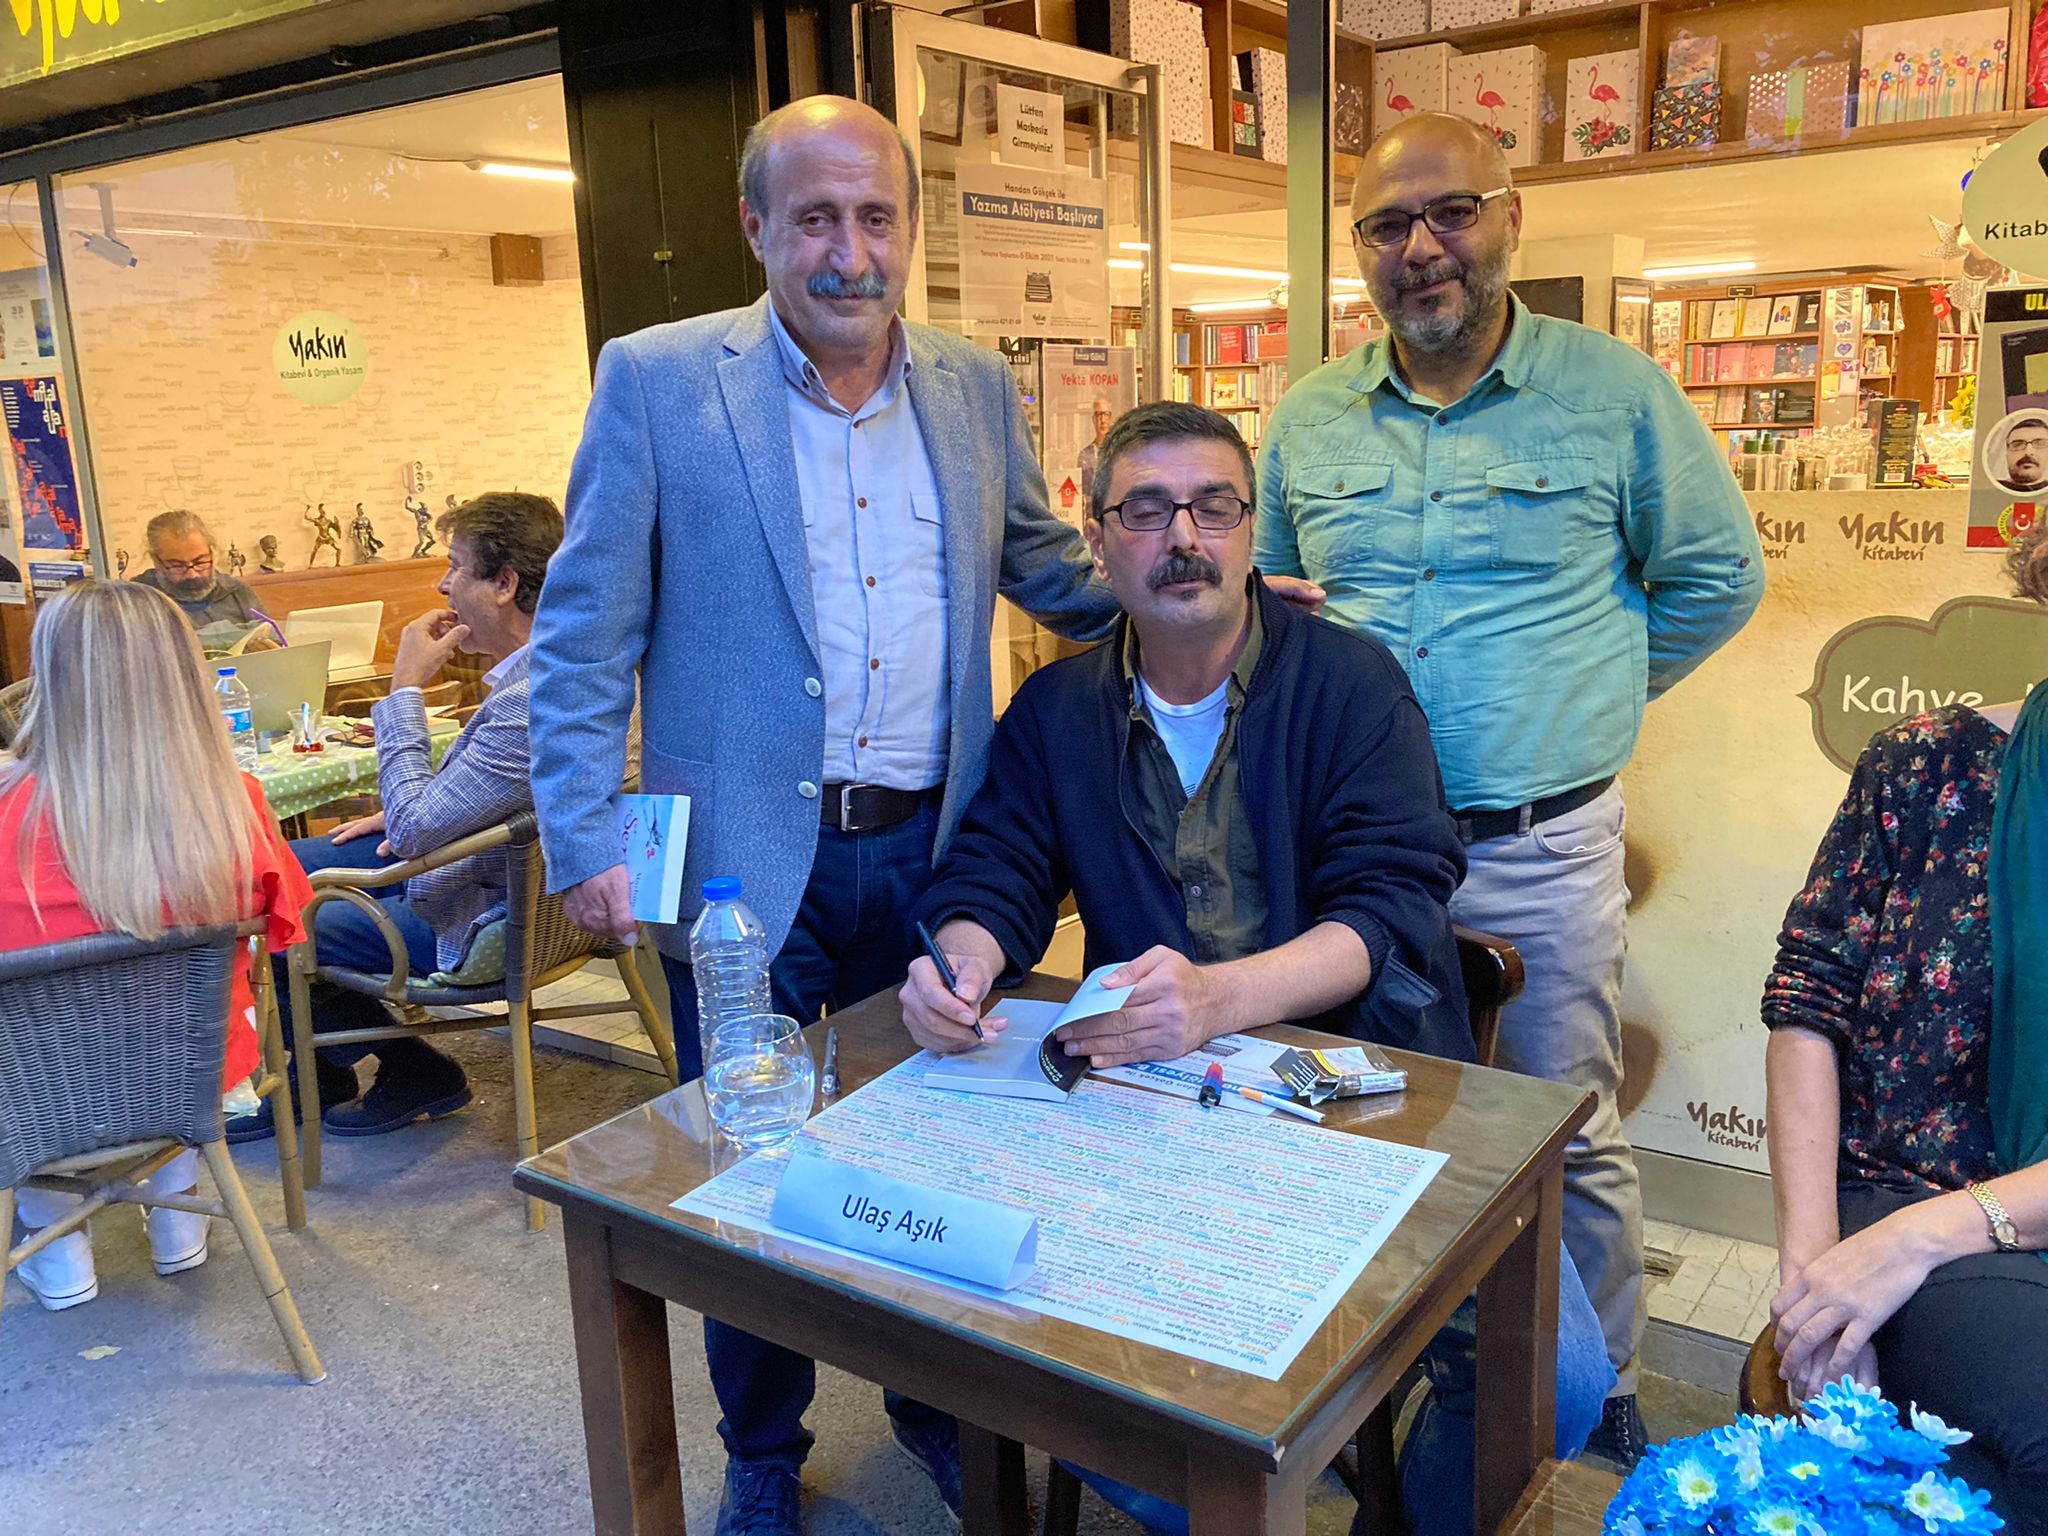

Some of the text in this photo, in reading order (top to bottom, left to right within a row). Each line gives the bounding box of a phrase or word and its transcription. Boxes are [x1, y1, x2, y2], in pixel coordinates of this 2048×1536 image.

[1020, 103, 1044, 117] Lütfen
[1016, 120, 1048, 136] Maskesiz
[1012, 136, 1053, 153] Girmeyiniz!
[1004, 182, 1031, 194] Handan
[1057, 190, 1066, 199] ile
[969, 195, 1098, 227] Yazma Atölyesi Başlıyor
[288, 326, 347, 368] Yakın
[280, 366, 364, 379] Kitabevi & Organik Yaşam
[1061, 373, 1119, 386] Yekta KOPAN
[1755, 510, 1806, 544] kın
[1838, 510, 1945, 550] Yakın
[841, 1194, 949, 1244] Ulaş Aşık
